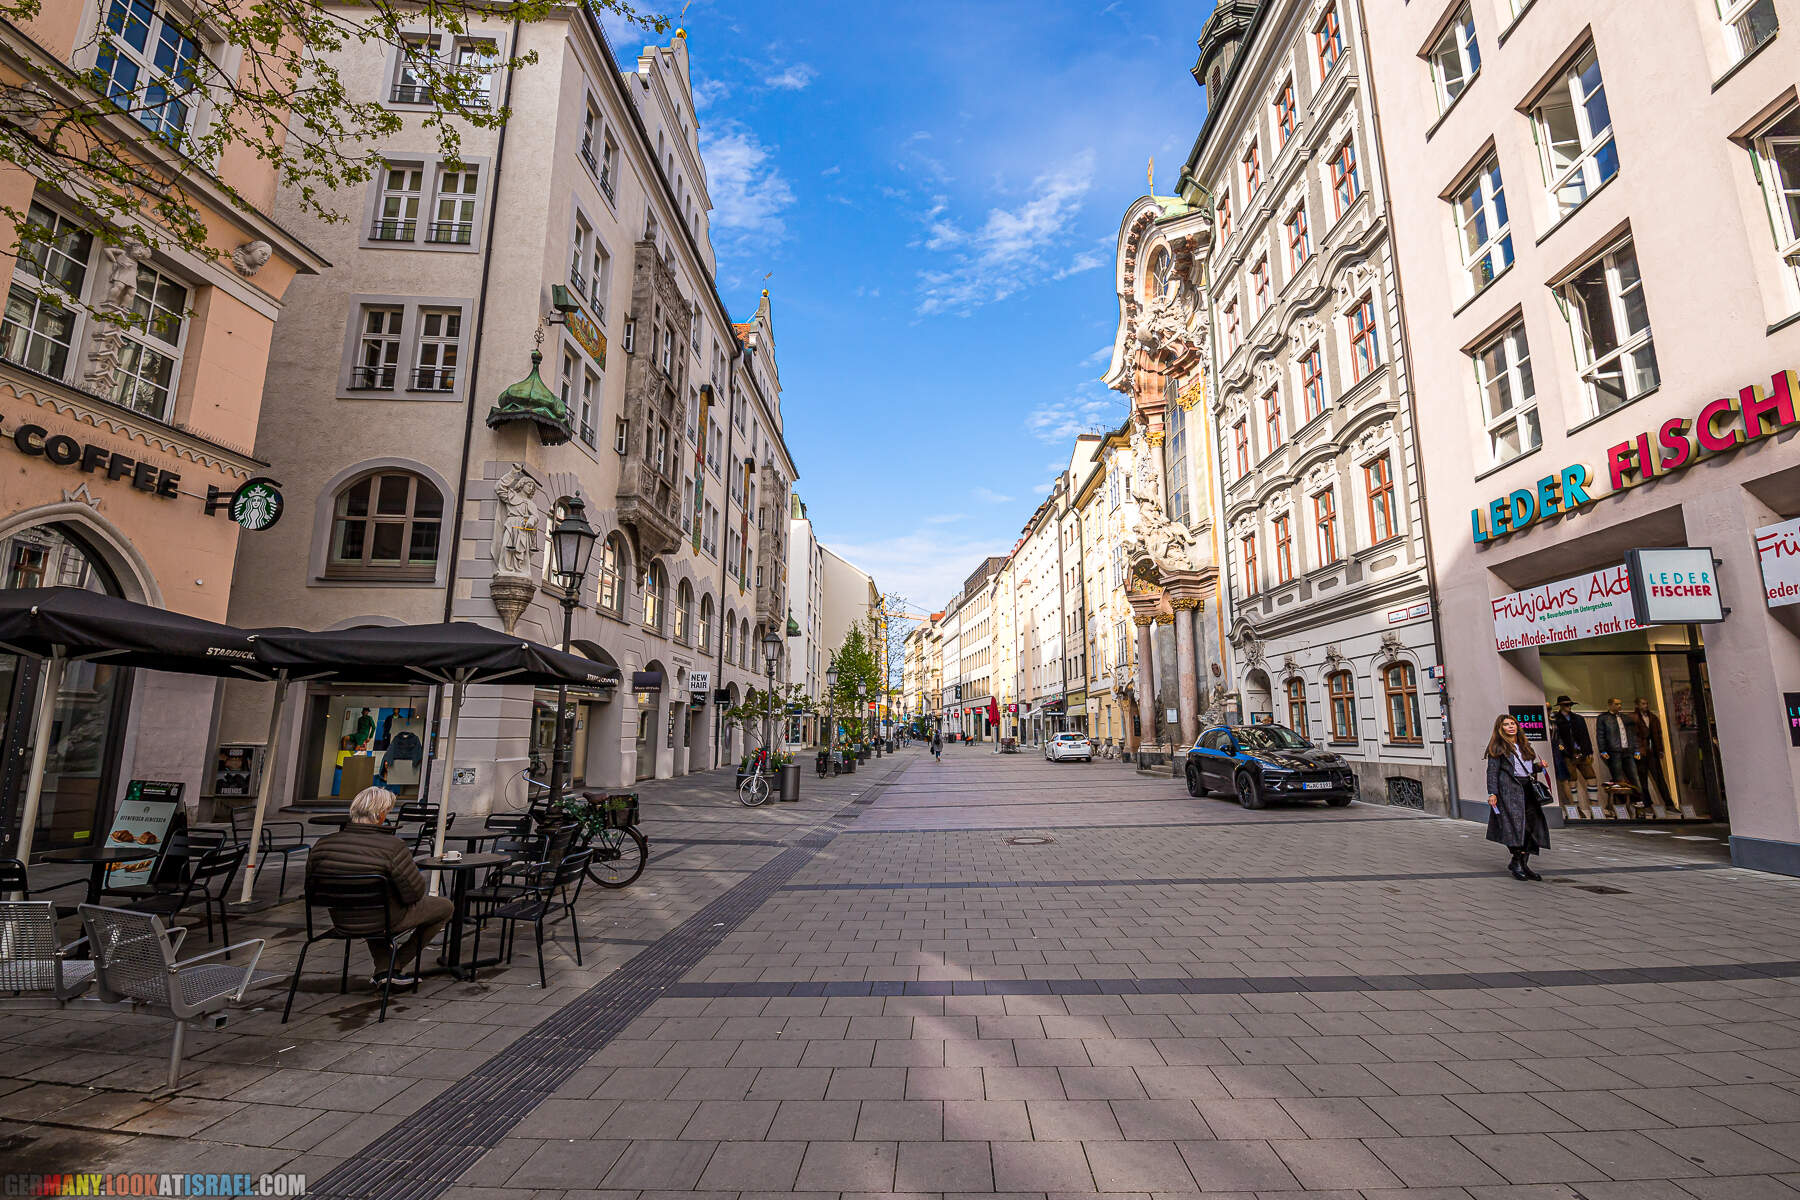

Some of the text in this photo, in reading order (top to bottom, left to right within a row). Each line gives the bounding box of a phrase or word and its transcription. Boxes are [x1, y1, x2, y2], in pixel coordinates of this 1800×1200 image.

[14, 424, 182, 498] COFFEE
[1471, 369, 1800, 544] LEDER FISCH
[1756, 530, 1800, 562] Frü
[1649, 571, 1710, 584] LEDER
[1491, 567, 1631, 622] Frühjahrs Akti
[1651, 585, 1712, 597] FISCHER
[1767, 581, 1800, 600] eder
[1496, 625, 1578, 650] Leder-Mode-Tracht
[1594, 616, 1622, 635] stark
[206, 647, 255, 660] STARBUCK
[690, 681, 707, 689] HAIR
